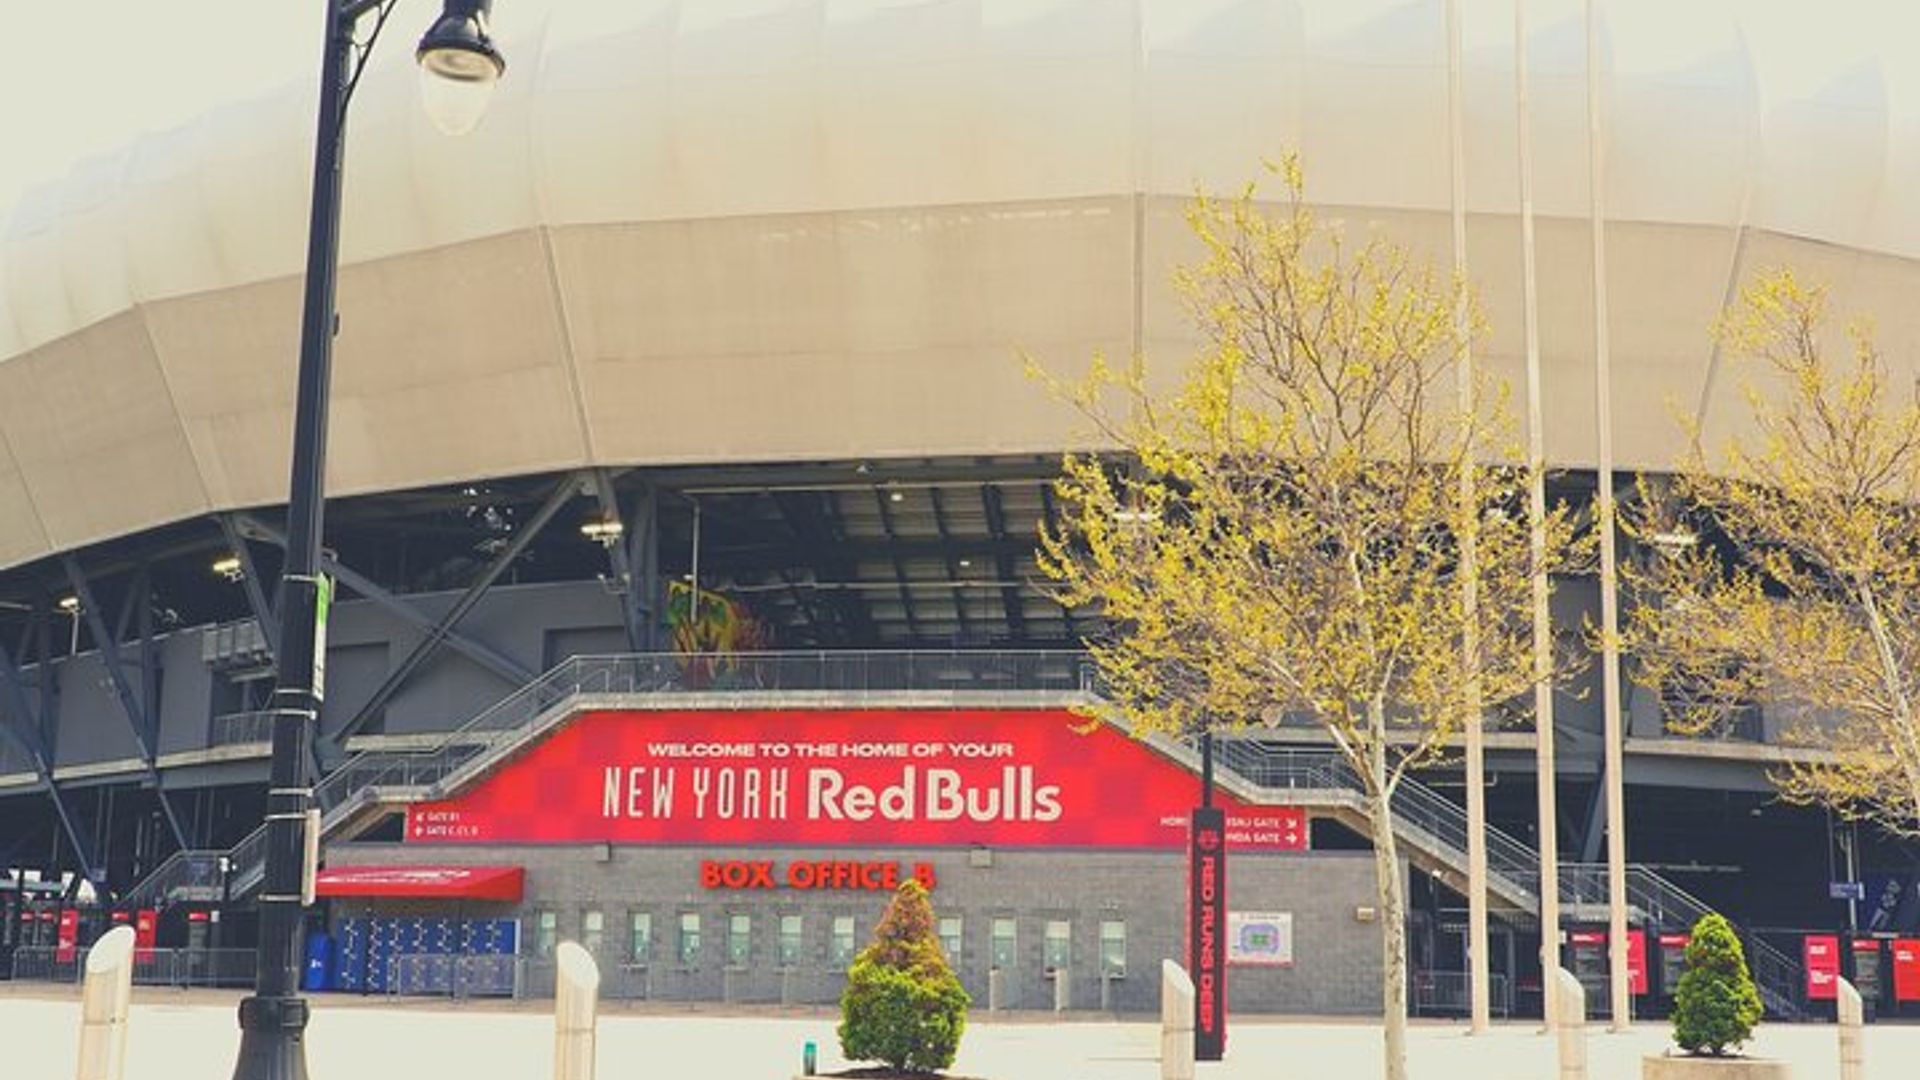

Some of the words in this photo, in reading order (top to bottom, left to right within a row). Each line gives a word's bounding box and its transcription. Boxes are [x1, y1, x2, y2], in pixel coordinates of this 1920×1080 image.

[648, 743, 755, 757] WELCOME
[760, 743, 789, 757] TO
[794, 743, 838, 757] THE
[841, 743, 908, 757] HOME
[912, 743, 943, 757] OF
[949, 743, 1013, 757] YOUR
[603, 766, 674, 819] NEW
[693, 766, 788, 820] YORK
[808, 765, 916, 820] Red
[926, 765, 1063, 821] Bulls
[1253, 817, 1280, 828] GATE
[1253, 832, 1280, 844] GATE
[702, 860, 774, 889] BOX
[788, 860, 898, 890] OFFICE
[914, 862, 936, 889] B
[1202, 856, 1215, 901] RED
[1202, 905, 1214, 969] RUNS
[1201, 973, 1214, 1034] DEEP
